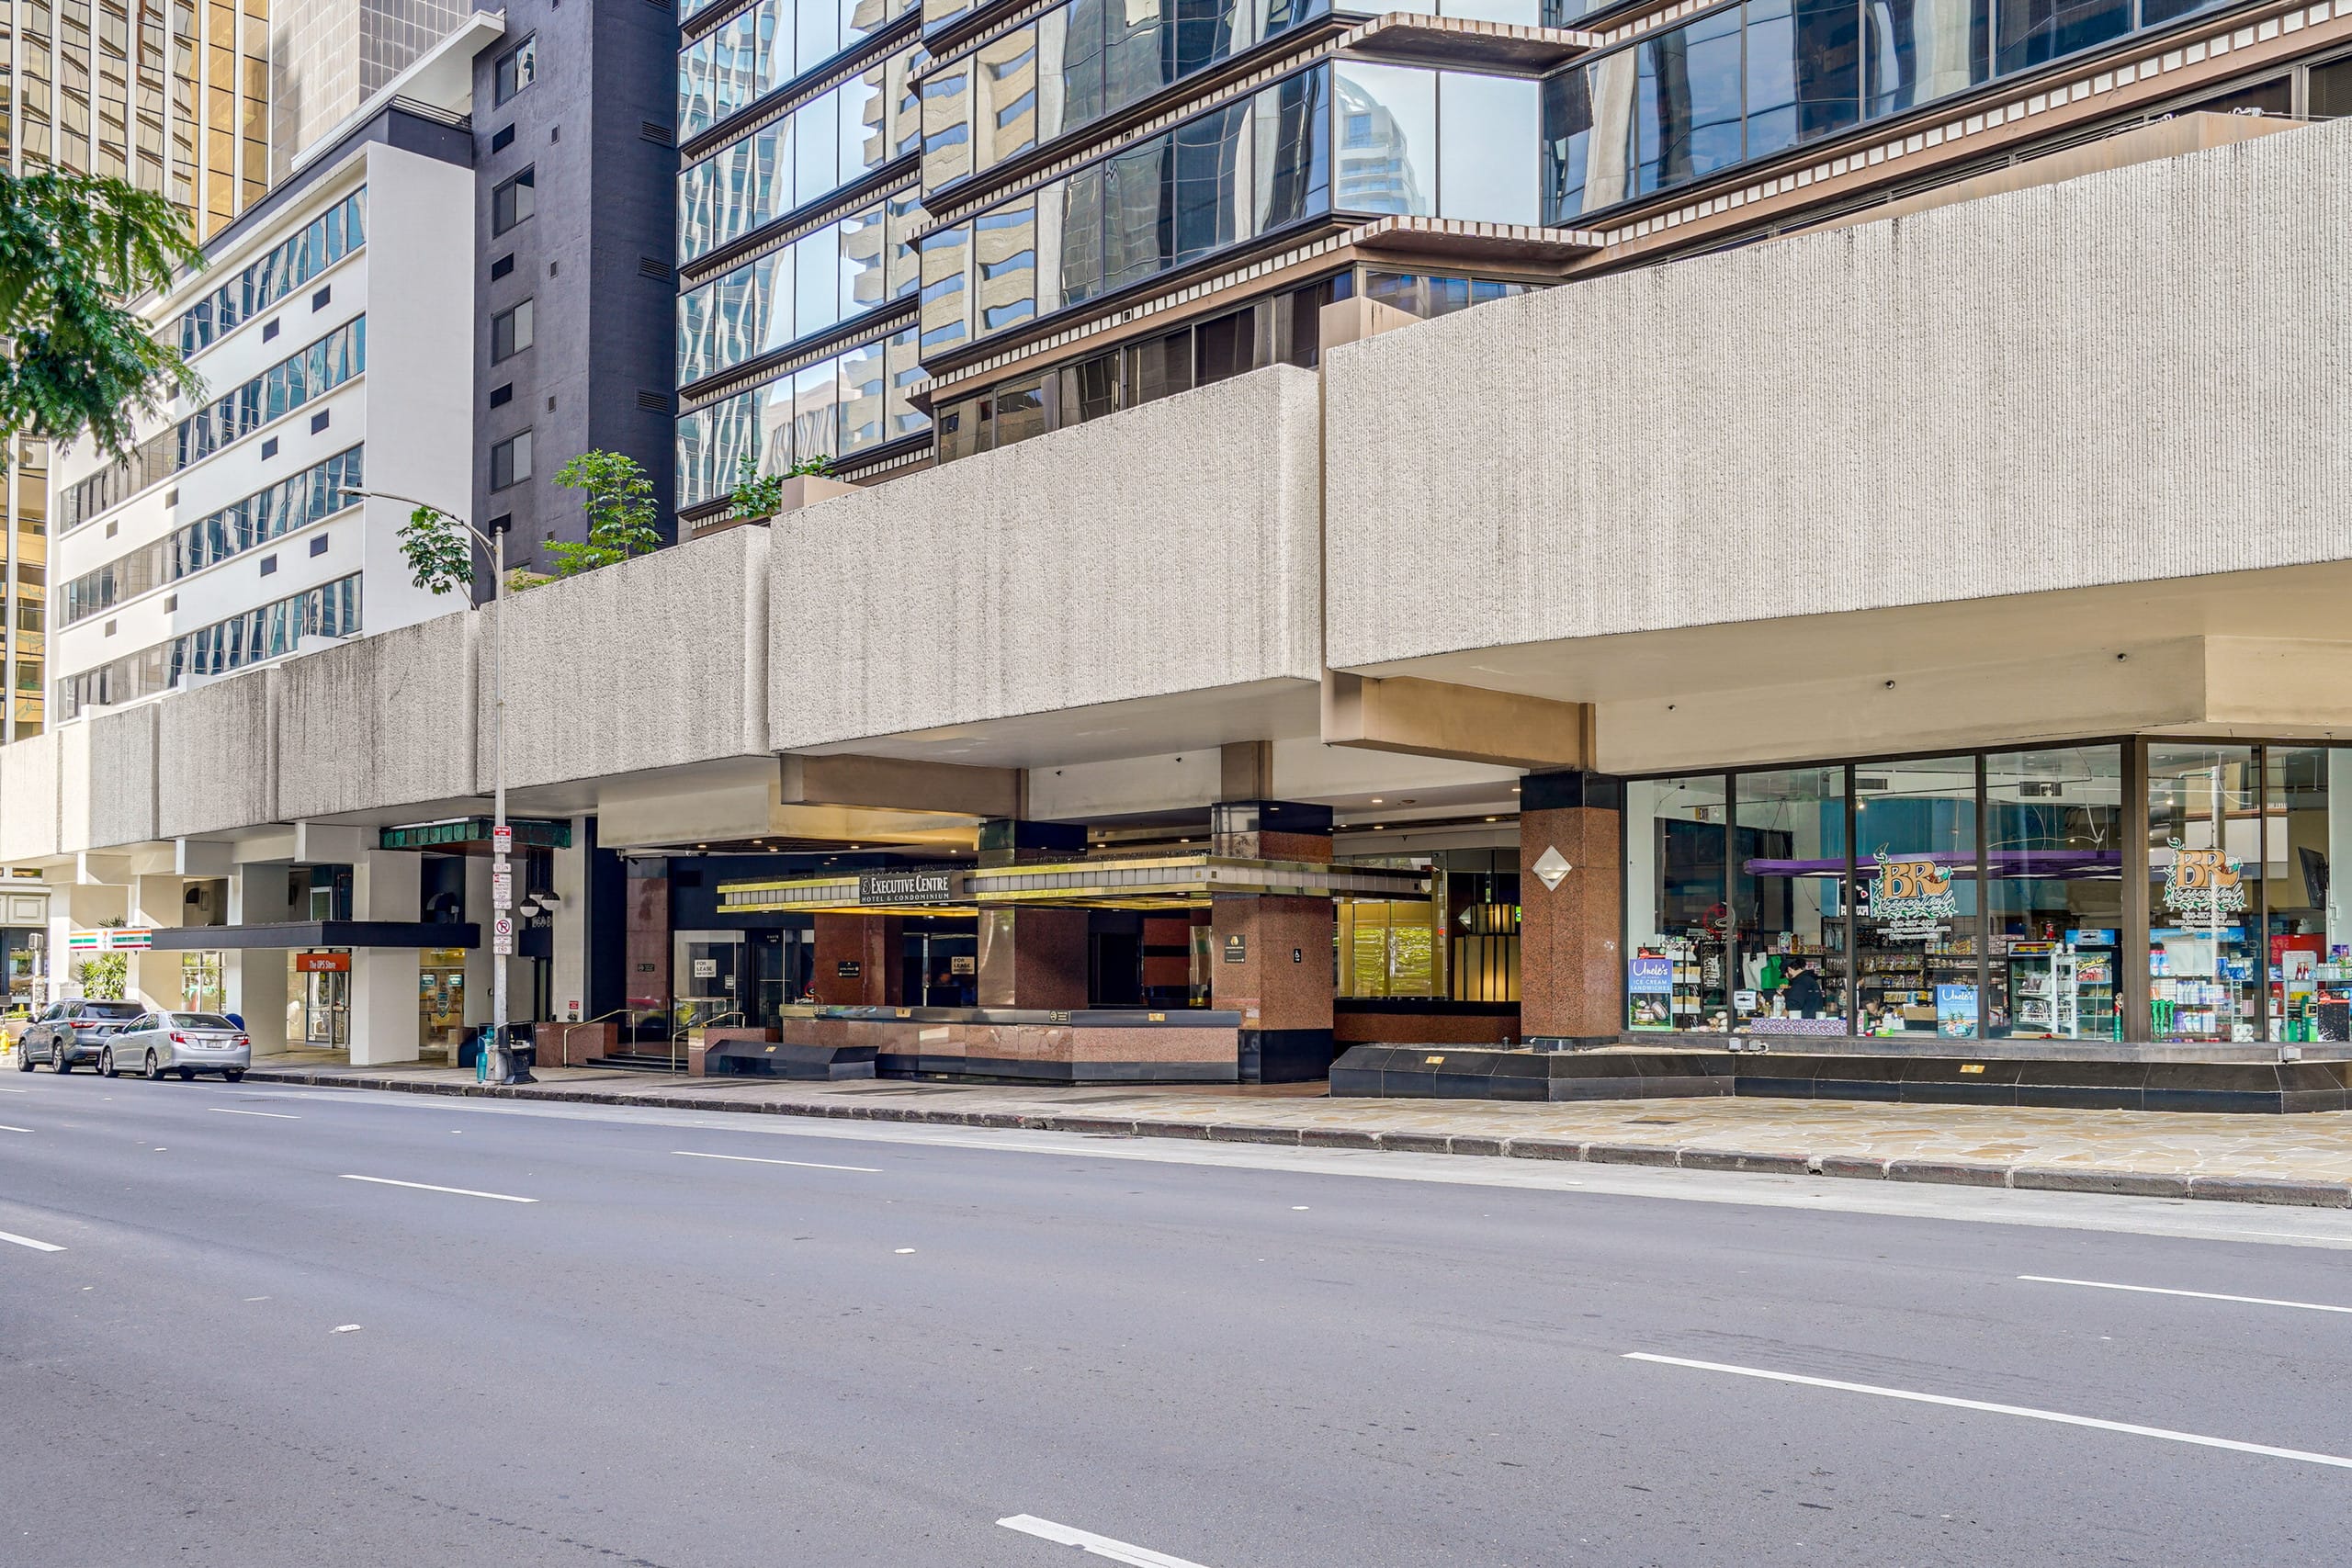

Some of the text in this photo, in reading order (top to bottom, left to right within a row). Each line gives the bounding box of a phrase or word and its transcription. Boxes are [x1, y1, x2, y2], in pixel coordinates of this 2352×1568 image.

[2175, 850, 2239, 888] BR
[871, 874, 949, 894] EXECUTIVE CENTRE
[1881, 861, 1950, 899] BR
[894, 893, 949, 901] CONDOMINIUM
[1633, 961, 1668, 976] Uncle's
